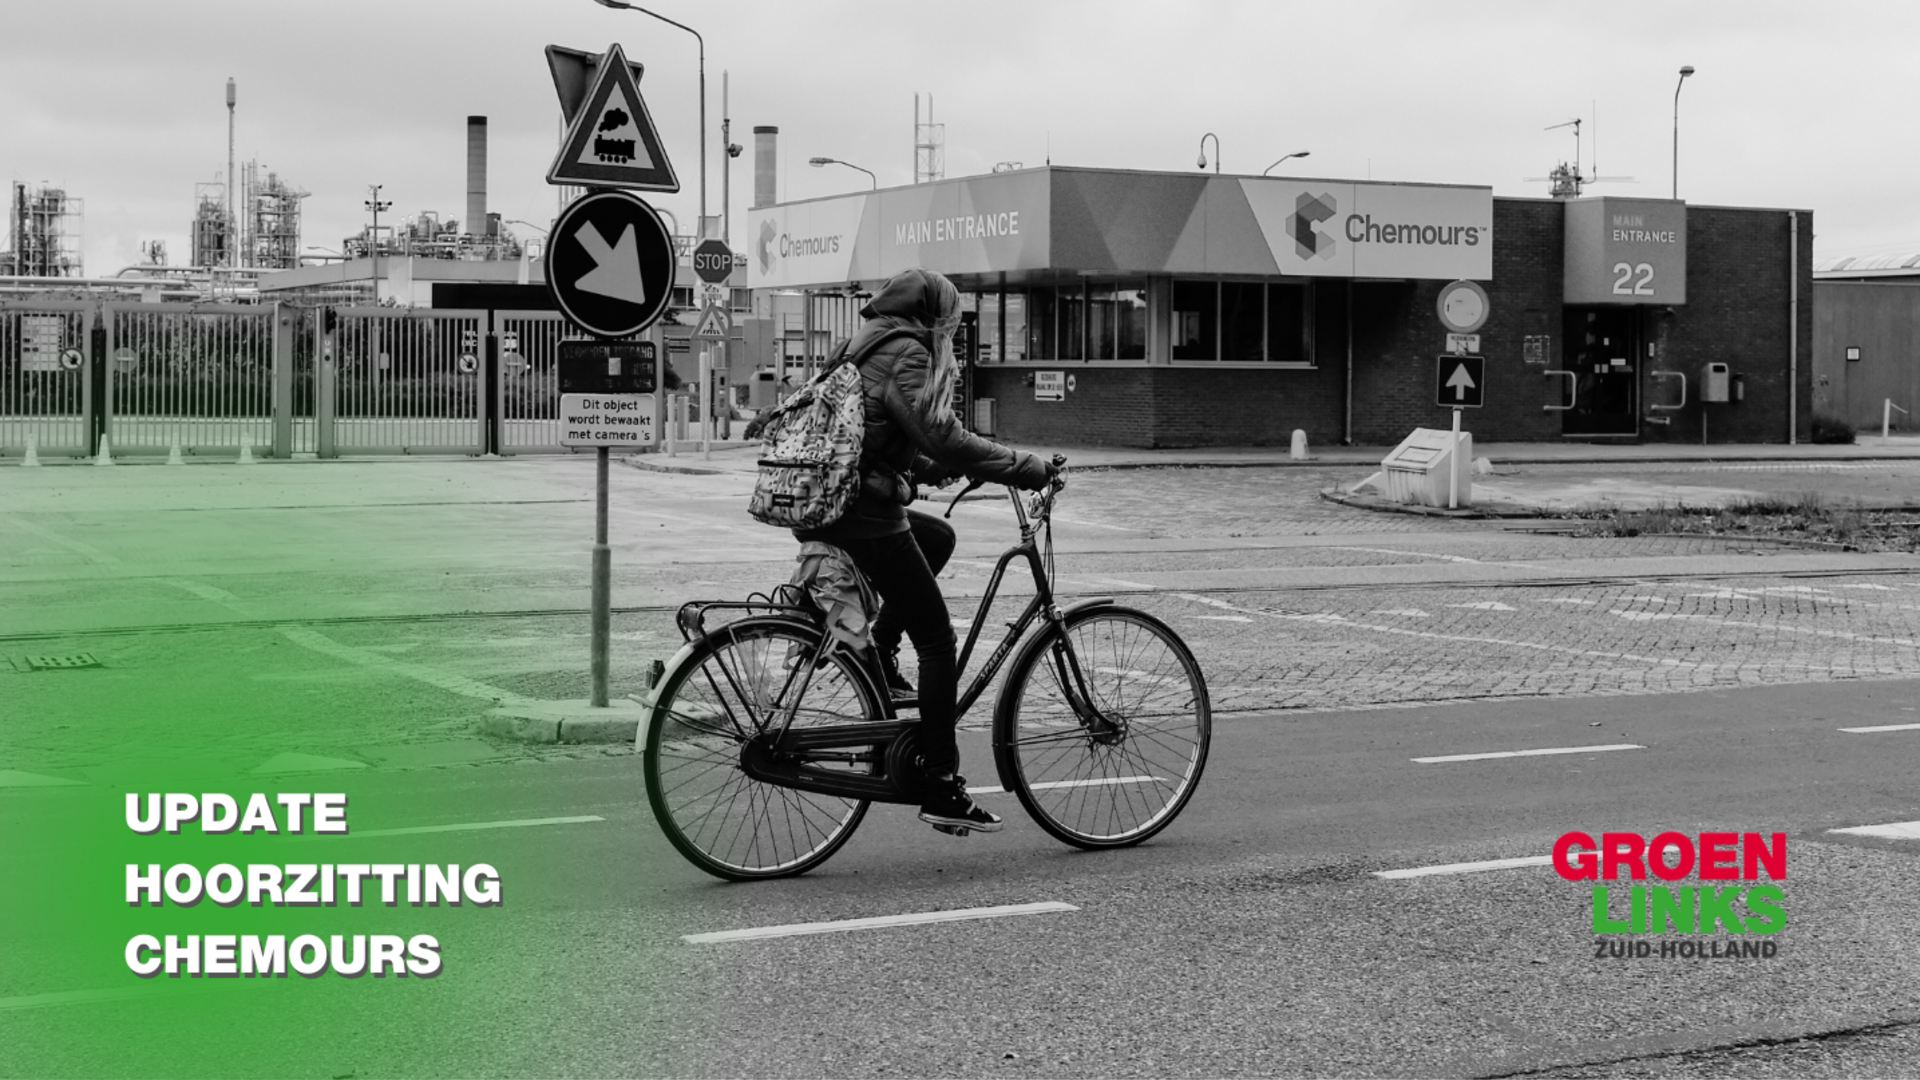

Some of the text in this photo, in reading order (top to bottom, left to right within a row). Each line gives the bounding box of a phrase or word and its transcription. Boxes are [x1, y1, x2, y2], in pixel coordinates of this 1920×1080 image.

[895, 211, 1019, 246] MAIN ENTRANCE
[1613, 215, 1643, 227] MAIN
[1613, 229, 1676, 243] ENTRANCE
[695, 253, 732, 270] STOP
[1613, 262, 1655, 296] 22
[582, 398, 638, 414] Dit object
[568, 414, 651, 426] wordt bewaakt
[568, 429, 591, 440] met
[980, 642, 1008, 681] SPARTA
